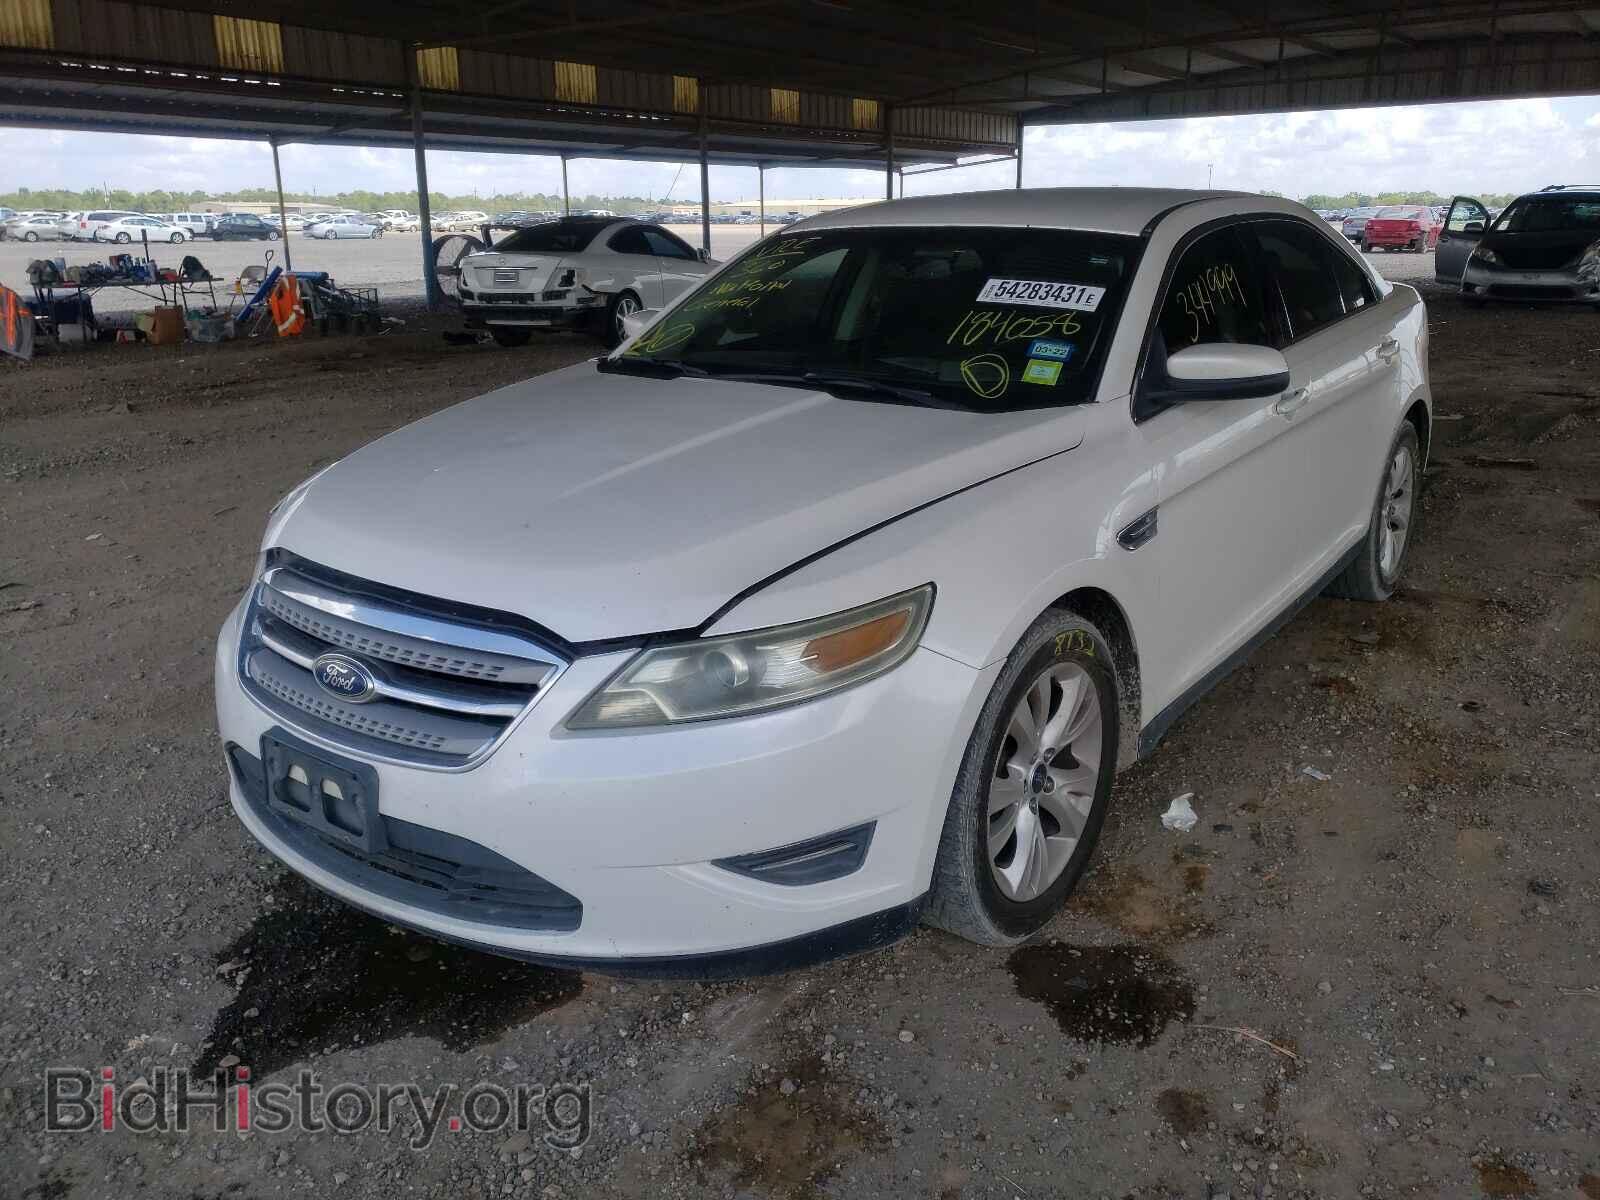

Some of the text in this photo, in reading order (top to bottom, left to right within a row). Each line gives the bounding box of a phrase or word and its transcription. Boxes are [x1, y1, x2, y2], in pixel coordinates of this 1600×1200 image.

[994, 280, 1087, 305] 54283431
[1086, 294, 1096, 304] E
[323, 664, 356, 690] Ford
